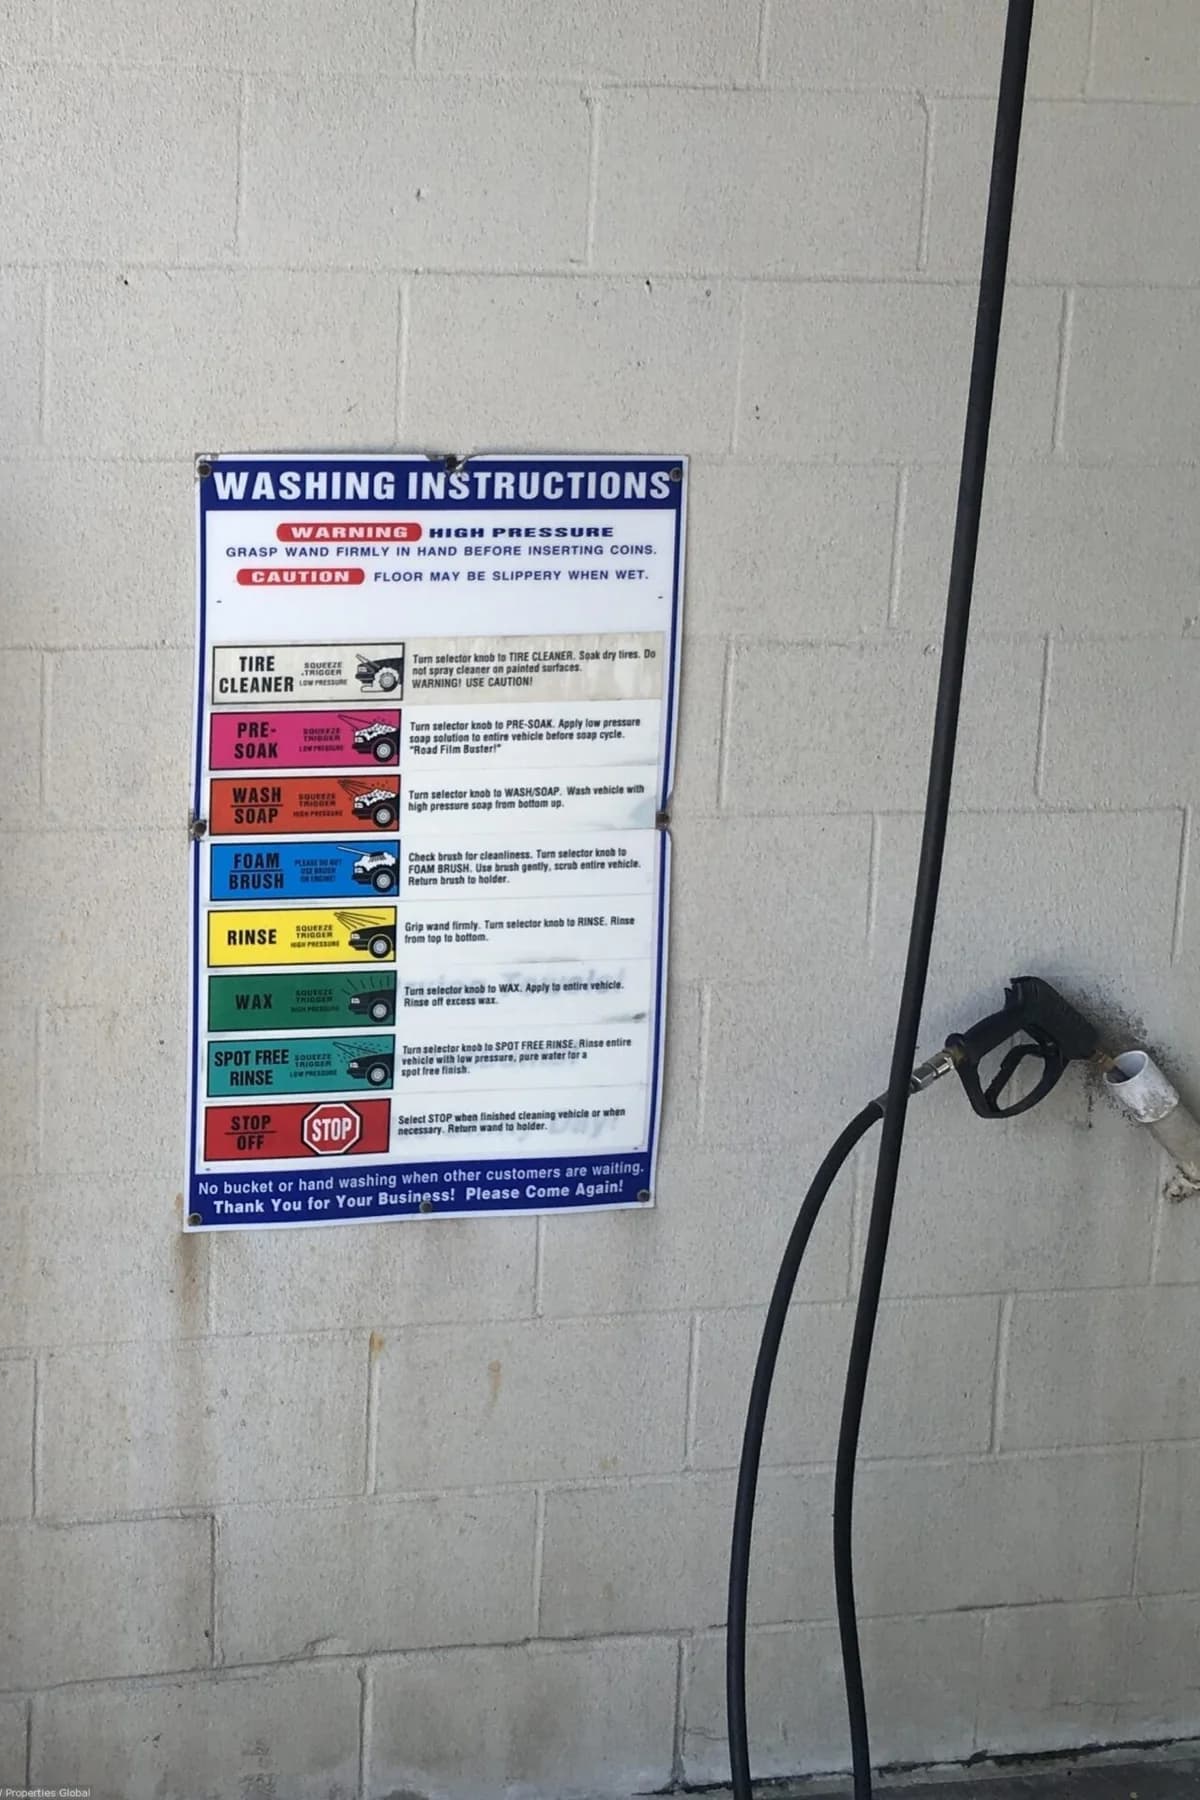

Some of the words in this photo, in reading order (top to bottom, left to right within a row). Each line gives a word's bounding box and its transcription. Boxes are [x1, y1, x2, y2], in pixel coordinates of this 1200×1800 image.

[214, 470, 396, 500] WASHING
[409, 470, 672, 500] INSTRUCTIONS
[290, 526, 408, 538] WARNING
[429, 527, 484, 538] HIGH
[492, 527, 613, 538] PRESSURE
[225, 546, 277, 557] GRASP
[284, 546, 329, 557] WAND
[336, 546, 389, 556] FIRMLY
[396, 546, 410, 556] IN
[417, 546, 457, 556] HAND
[463, 545, 521, 556] BEFORE
[528, 545, 603, 555] INSERTING
[609, 544, 656, 555] COINS.
[251, 570, 349, 582] CAUTION
[373, 571, 423, 582] FLOOR
[429, 571, 460, 581] MAY
[466, 570, 485, 581] BE
[492, 570, 561, 581] SLIPPERY
[567, 569, 608, 580] WHEN
[615, 569, 648, 579] WET.
[239, 655, 274, 672] TIRE
[412, 653, 433, 664] Turn
[435, 653, 471, 663] selector
[473, 652, 495, 662] knob
[497, 652, 506, 662] to
[509, 651, 529, 661] TIRE
[578, 650, 600, 660] Soak
[602, 650, 616, 661] dry
[643, 649, 656, 658] Do
[219, 676, 293, 693] CLEANER
[465, 677, 484, 687] USE
[237, 721, 276, 738] PRE-
[410, 721, 430, 731] Turn
[432, 720, 469, 731] selector
[470, 720, 492, 730] knob
[494, 720, 503, 729] to
[558, 718, 583, 730] Apply
[585, 718, 600, 727] low
[602, 718, 640, 728] pressure
[234, 742, 277, 759] SOAK
[439, 744, 461, 754] Film
[232, 786, 282, 803] WASH
[408, 801, 428, 813] high
[430, 802, 469, 811] pressure
[471, 801, 492, 811] soap
[494, 799, 515, 809] from
[517, 798, 548, 808] bottom
[234, 808, 278, 824] SOAP
[234, 852, 279, 869] FOAM
[408, 851, 435, 862] Check
[438, 851, 462, 861] brush
[465, 850, 477, 860] for
[536, 849, 555, 858] Turn
[558, 848, 592, 858] selector
[595, 848, 615, 857] knob
[618, 847, 626, 856] to
[229, 873, 283, 890] BRUSH
[404, 921, 423, 933] Grip
[426, 921, 449, 931] wand
[484, 919, 503, 929] Turn
[506, 919, 541, 928] selector
[543, 918, 564, 927] knob
[566, 917, 575, 927] to
[610, 916, 634, 925] Rinse
[227, 928, 276, 945] RINSE
[235, 993, 272, 1010] WAX
[404, 997, 429, 1007] Rinse
[431, 997, 443, 1006] off
[445, 997, 476, 1006] excess
[215, 1050, 252, 1067] SPOT
[256, 1049, 289, 1065] FREE
[230, 1069, 272, 1086] RINSE
[401, 1067, 420, 1077] spot
[422, 1066, 439, 1075] free
[231, 1114, 270, 1130] STOP
[398, 1114, 426, 1124] Select
[427, 1113, 452, 1125] STOP
[454, 1112, 478, 1122] when
[480, 1111, 515, 1121] finished
[518, 1110, 556, 1121] cleaning
[557, 1109, 589, 1118] vehicle
[591, 1109, 600, 1117] or
[602, 1108, 625, 1116] when
[311, 1117, 352, 1142] STOP
[237, 1134, 264, 1150] OFF
[198, 1181, 218, 1195] No
[223, 1179, 273, 1194] bucket
[278, 1181, 293, 1192] or
[298, 1176, 333, 1191] hand
[338, 1172, 396, 1190] washing
[401, 1170, 438, 1184] when
[443, 1168, 480, 1182] other
[486, 1166, 560, 1181] customers
[565, 1166, 587, 1177] are
[592, 1160, 644, 1177] waiting.
[213, 1198, 263, 1214] Thank
[271, 1197, 301, 1212] You
[308, 1195, 329, 1210] for
[336, 1193, 372, 1208] Your
[379, 1188, 454, 1204] Business!
[466, 1184, 519, 1201] Please
[526, 1183, 569, 1198] Come
[575, 1179, 622, 1198] Again!
